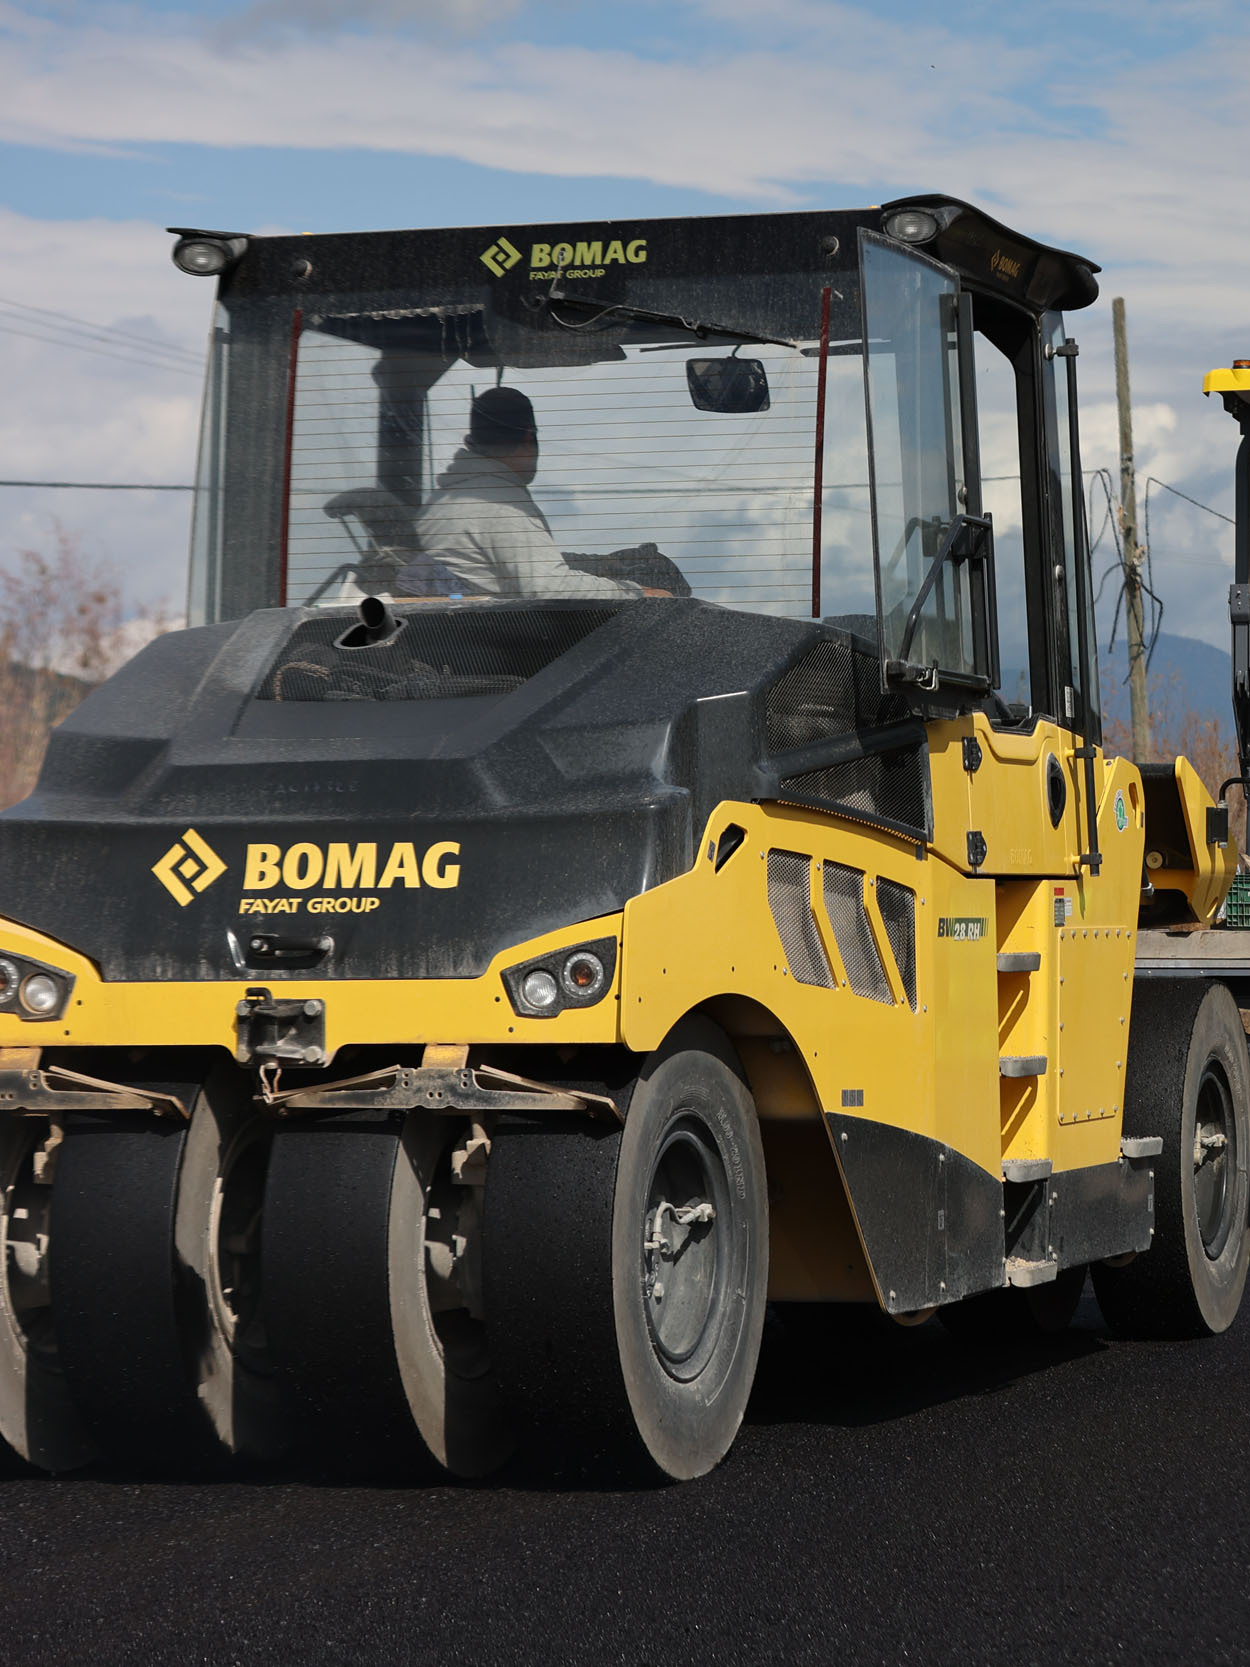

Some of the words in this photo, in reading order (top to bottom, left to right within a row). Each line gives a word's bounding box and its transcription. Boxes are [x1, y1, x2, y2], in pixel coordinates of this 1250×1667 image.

[530, 239, 647, 267] BOMAG
[529, 271, 563, 280] FAYAT
[566, 269, 605, 279] GROUP
[243, 841, 461, 890] BOMAG
[239, 898, 302, 914] FAYAT
[306, 897, 381, 913] GROUP
